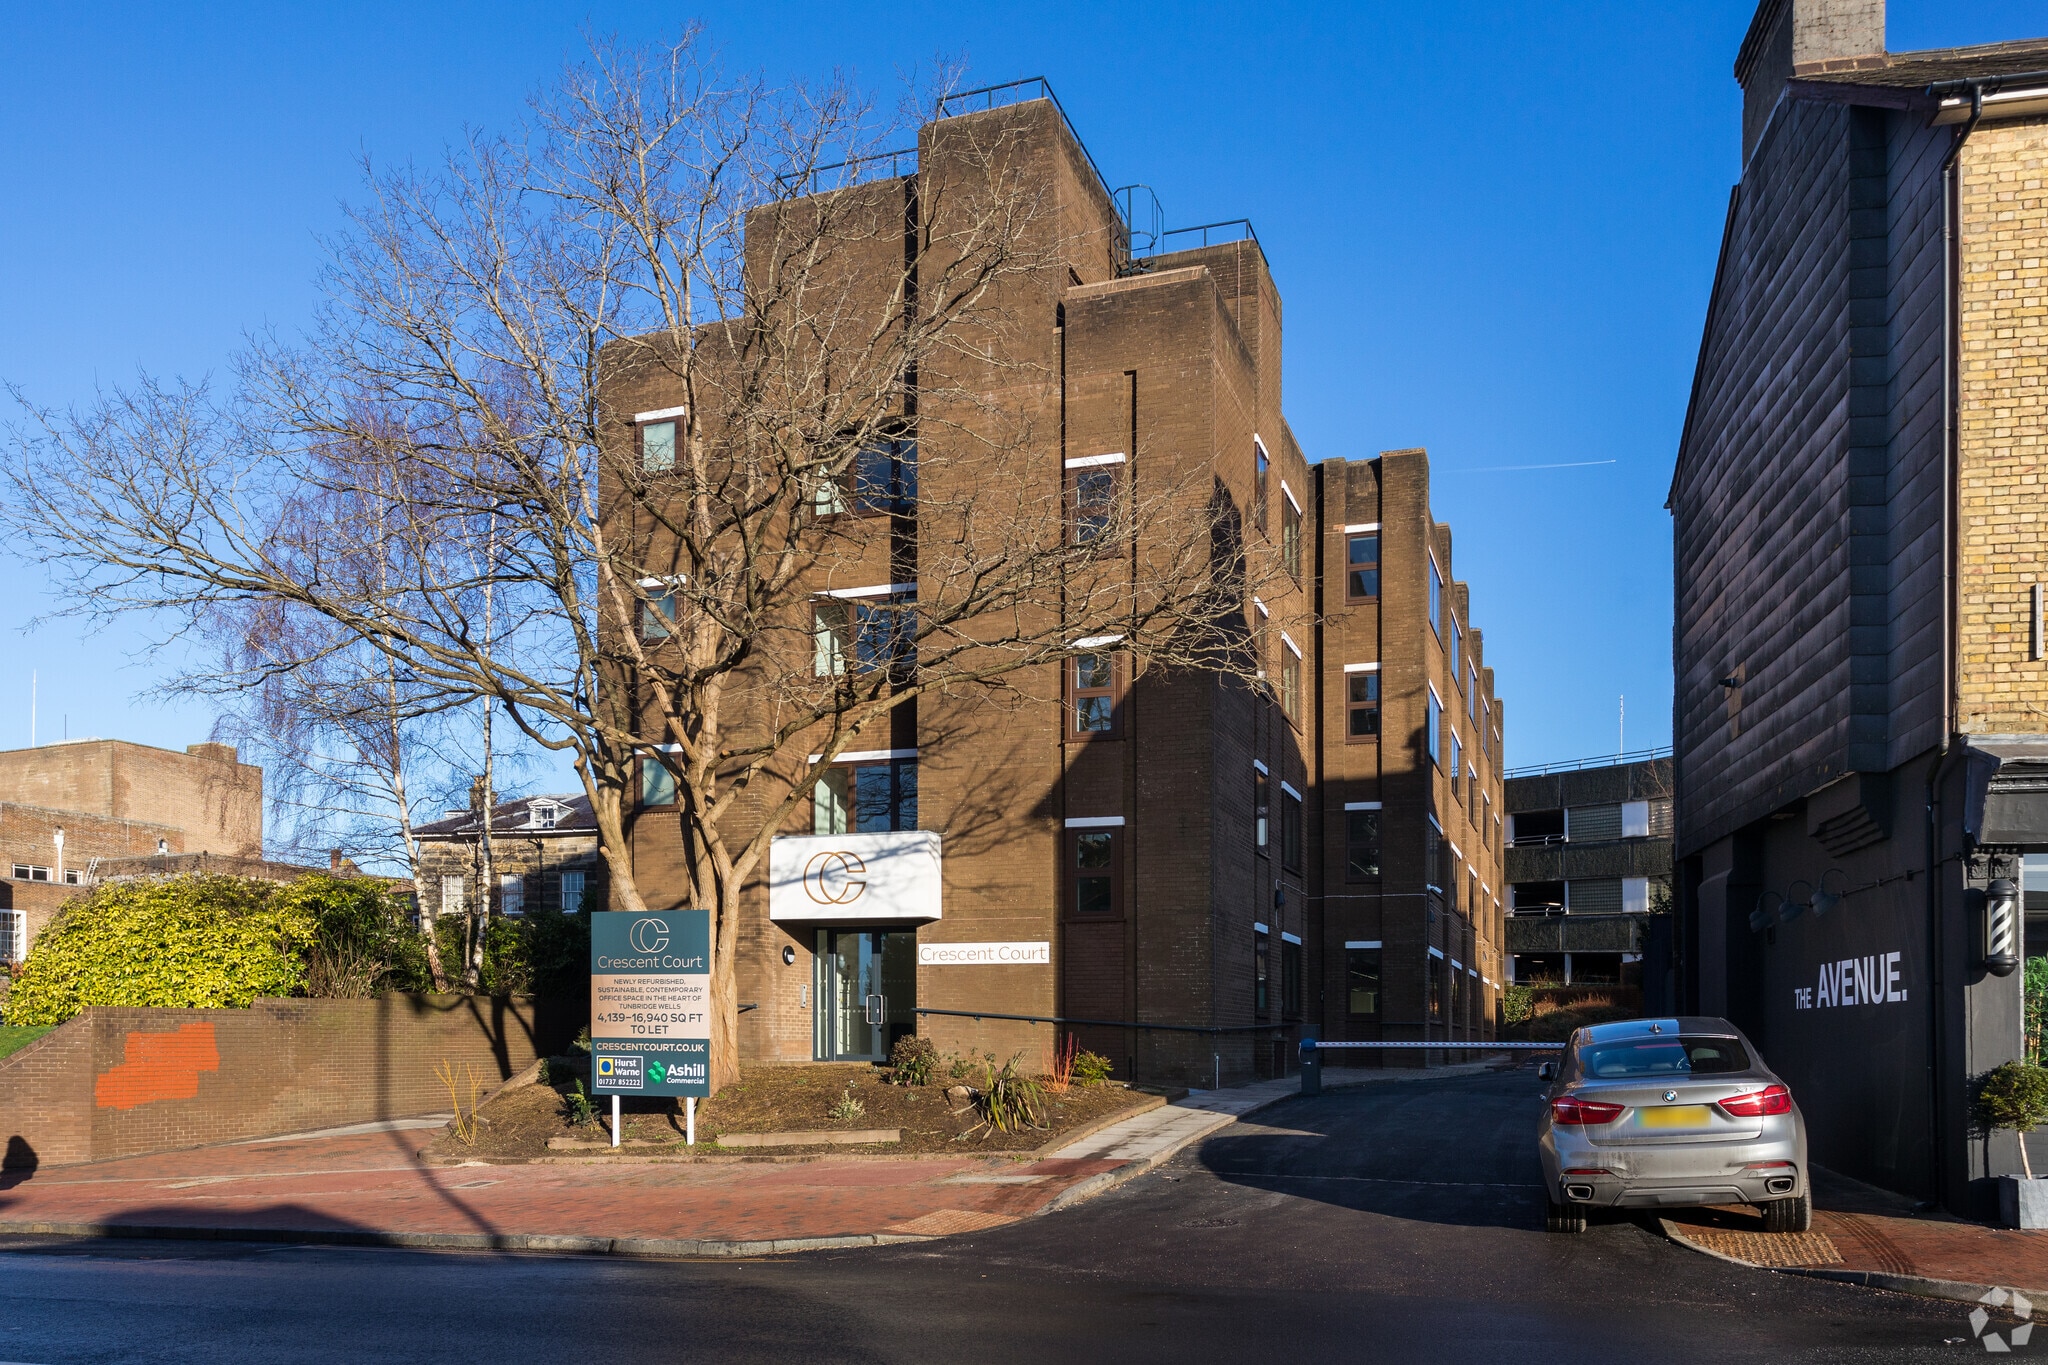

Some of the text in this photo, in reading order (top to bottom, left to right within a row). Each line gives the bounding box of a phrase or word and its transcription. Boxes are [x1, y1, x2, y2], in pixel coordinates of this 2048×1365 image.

[919, 945, 1047, 961] Crescent Court
[597, 955, 703, 969] Crescent Court
[1794, 951, 1908, 1010] THE AVENUE.
[670, 1013, 687, 1023] SQ
[688, 1013, 703, 1023] FT
[630, 1025, 669, 1034] TO LET
[596, 1042, 705, 1052] CRESCENTCOURT.CO.UK
[614, 1058, 637, 1067] Hurst
[614, 1068, 640, 1076] Warne
[667, 1063, 705, 1077] Ashill
[666, 1077, 705, 1085] Commercial
